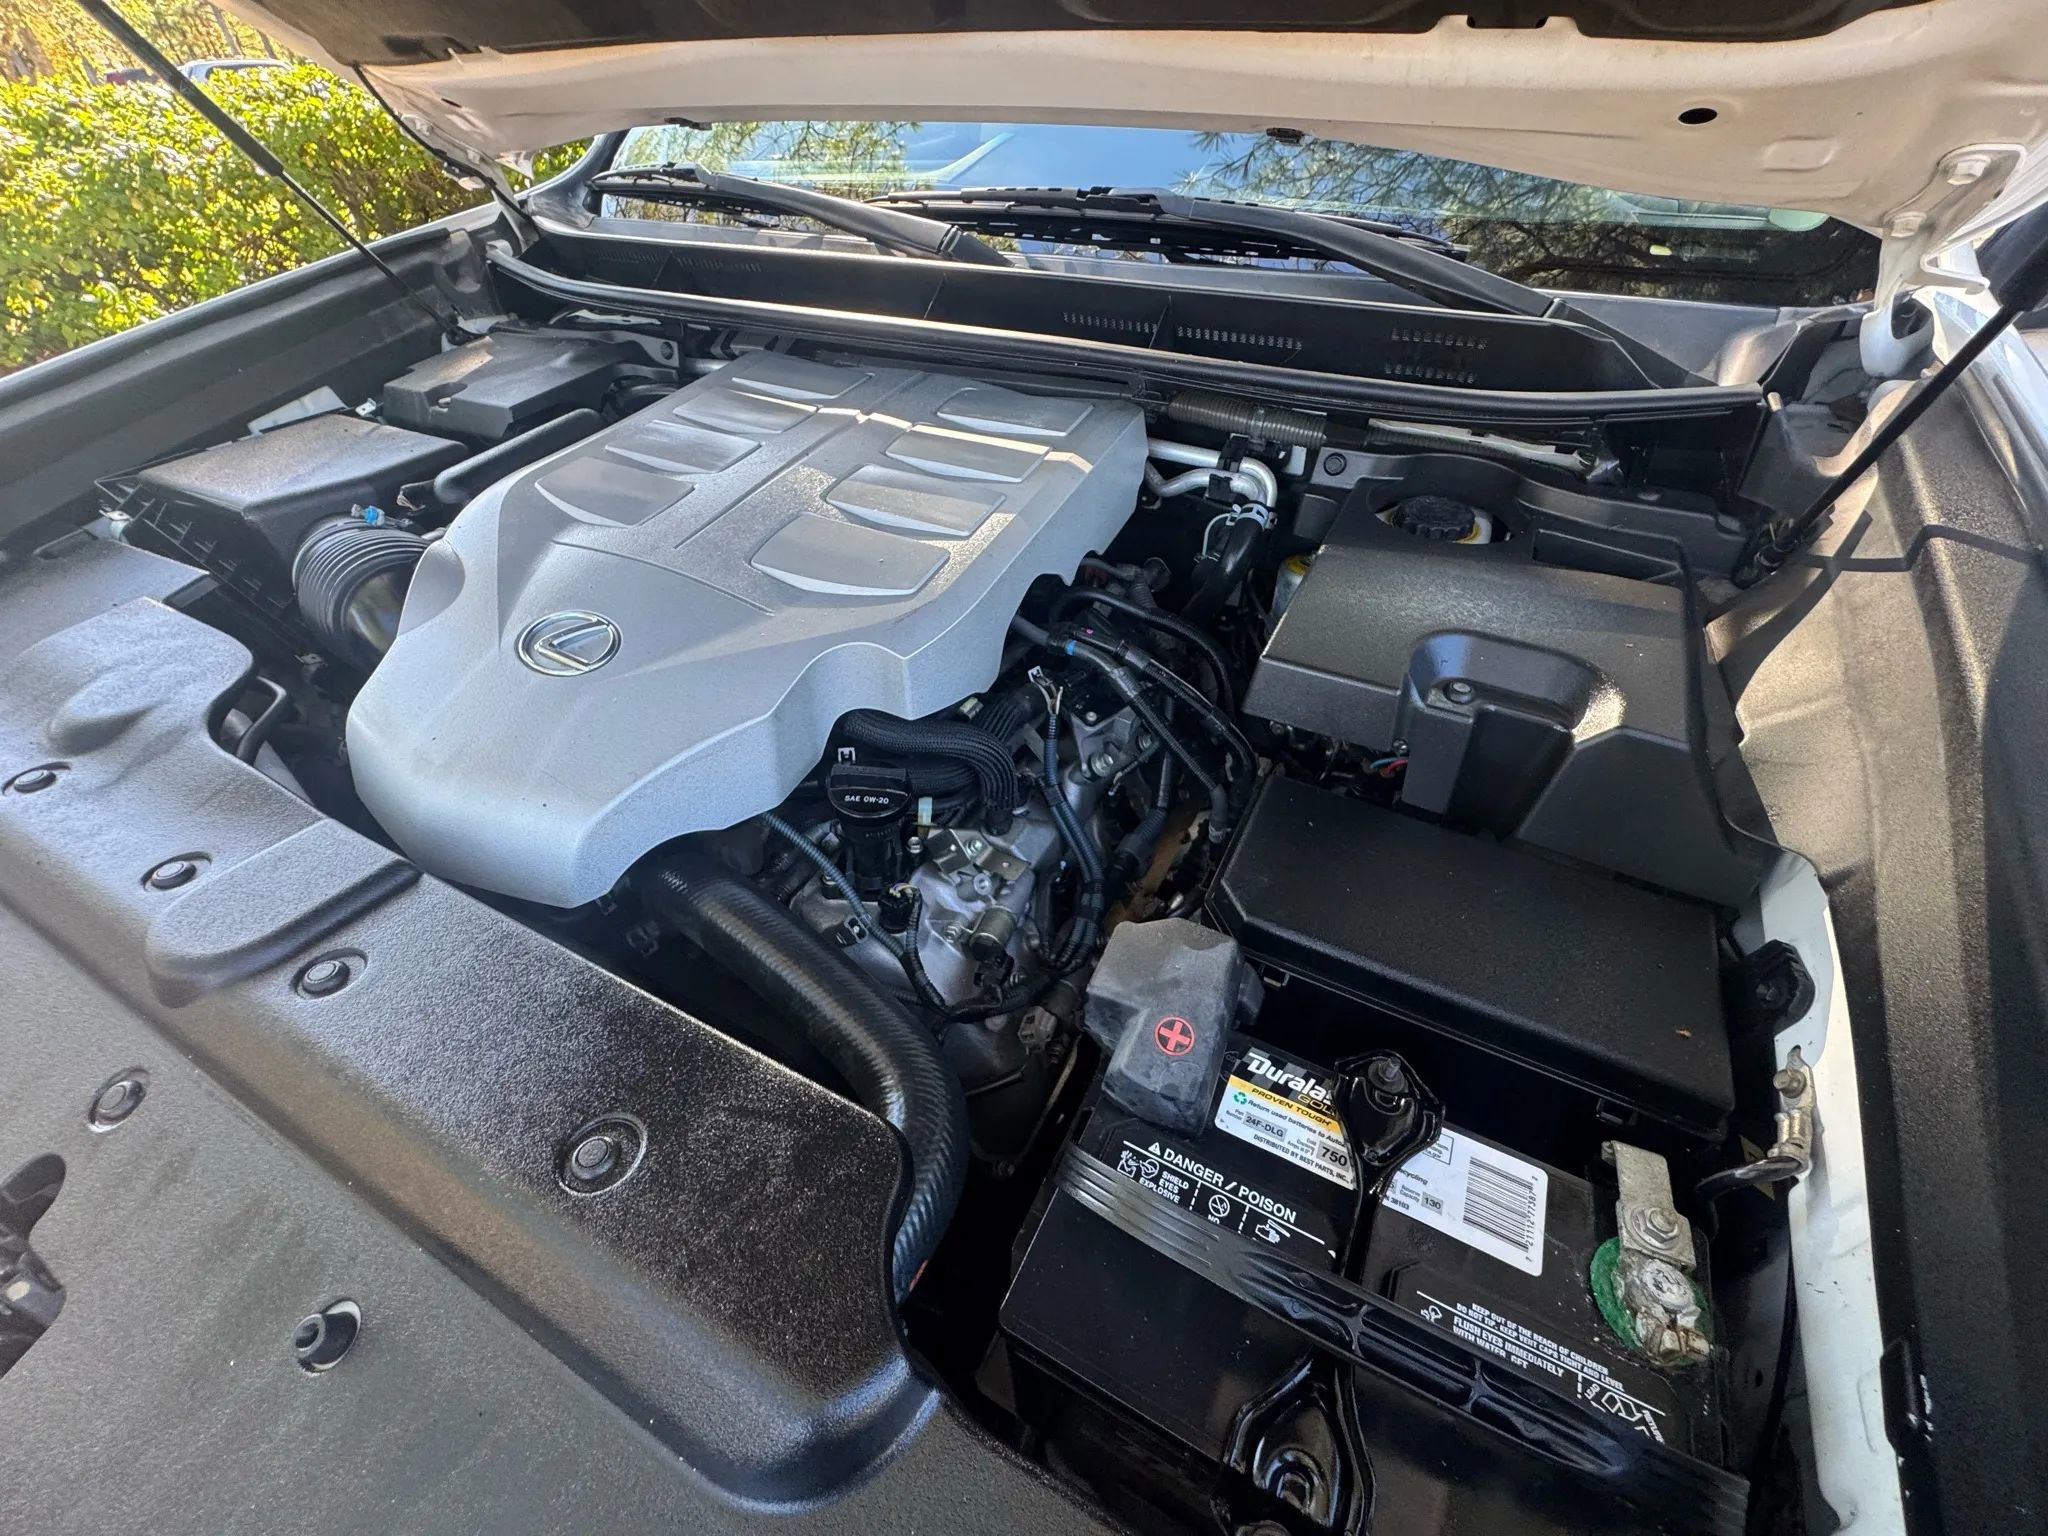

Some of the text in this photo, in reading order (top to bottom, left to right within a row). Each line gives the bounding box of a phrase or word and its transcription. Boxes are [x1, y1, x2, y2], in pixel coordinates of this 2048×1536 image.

[1247, 1052, 1334, 1106] Duralas
[1248, 1100, 1270, 1112] Return
[1271, 1111, 1288, 1120] used
[1288, 1117, 1317, 1134] batteries
[1252, 1088, 1331, 1126] PROVEN TOUGH
[1297, 1094, 1335, 1116] GOL
[1246, 1116, 1283, 1137] 24F-DLG
[1253, 1134, 1290, 1154] DISTRIBUTED
[1299, 1155, 1314, 1166] BEST
[1322, 1146, 1348, 1167] 750
[1139, 1177, 1180, 1203] EXPLOSIVE
[1159, 1178, 1179, 1193] EYES
[1162, 1171, 1189, 1189] SHIELD
[1164, 1148, 1224, 1186] DANGER
[1238, 1186, 1296, 1223] POISON
[1425, 1197, 1441, 1209] 130
[1453, 1326, 1475, 1342] WITH
[1454, 1316, 1564, 1377] FLUSH EYES IMMEDIATELY
[1472, 1303, 1608, 1375] KEEP OUT OF THE REACH OF CHILDREN
[1457, 1303, 1467, 1313] DO
[1468, 1309, 1483, 1321] NOT
[1500, 1325, 1517, 1337] KEEP
[1519, 1334, 1537, 1348] VENT
[1539, 1344, 1558, 1358] CAPS
[1560, 1354, 1582, 1370] TIGHT
[1583, 1366, 1599, 1378] AND
[1601, 1374, 1624, 1392] LEVEL
[1584, 1383, 1600, 1400] LEAD
